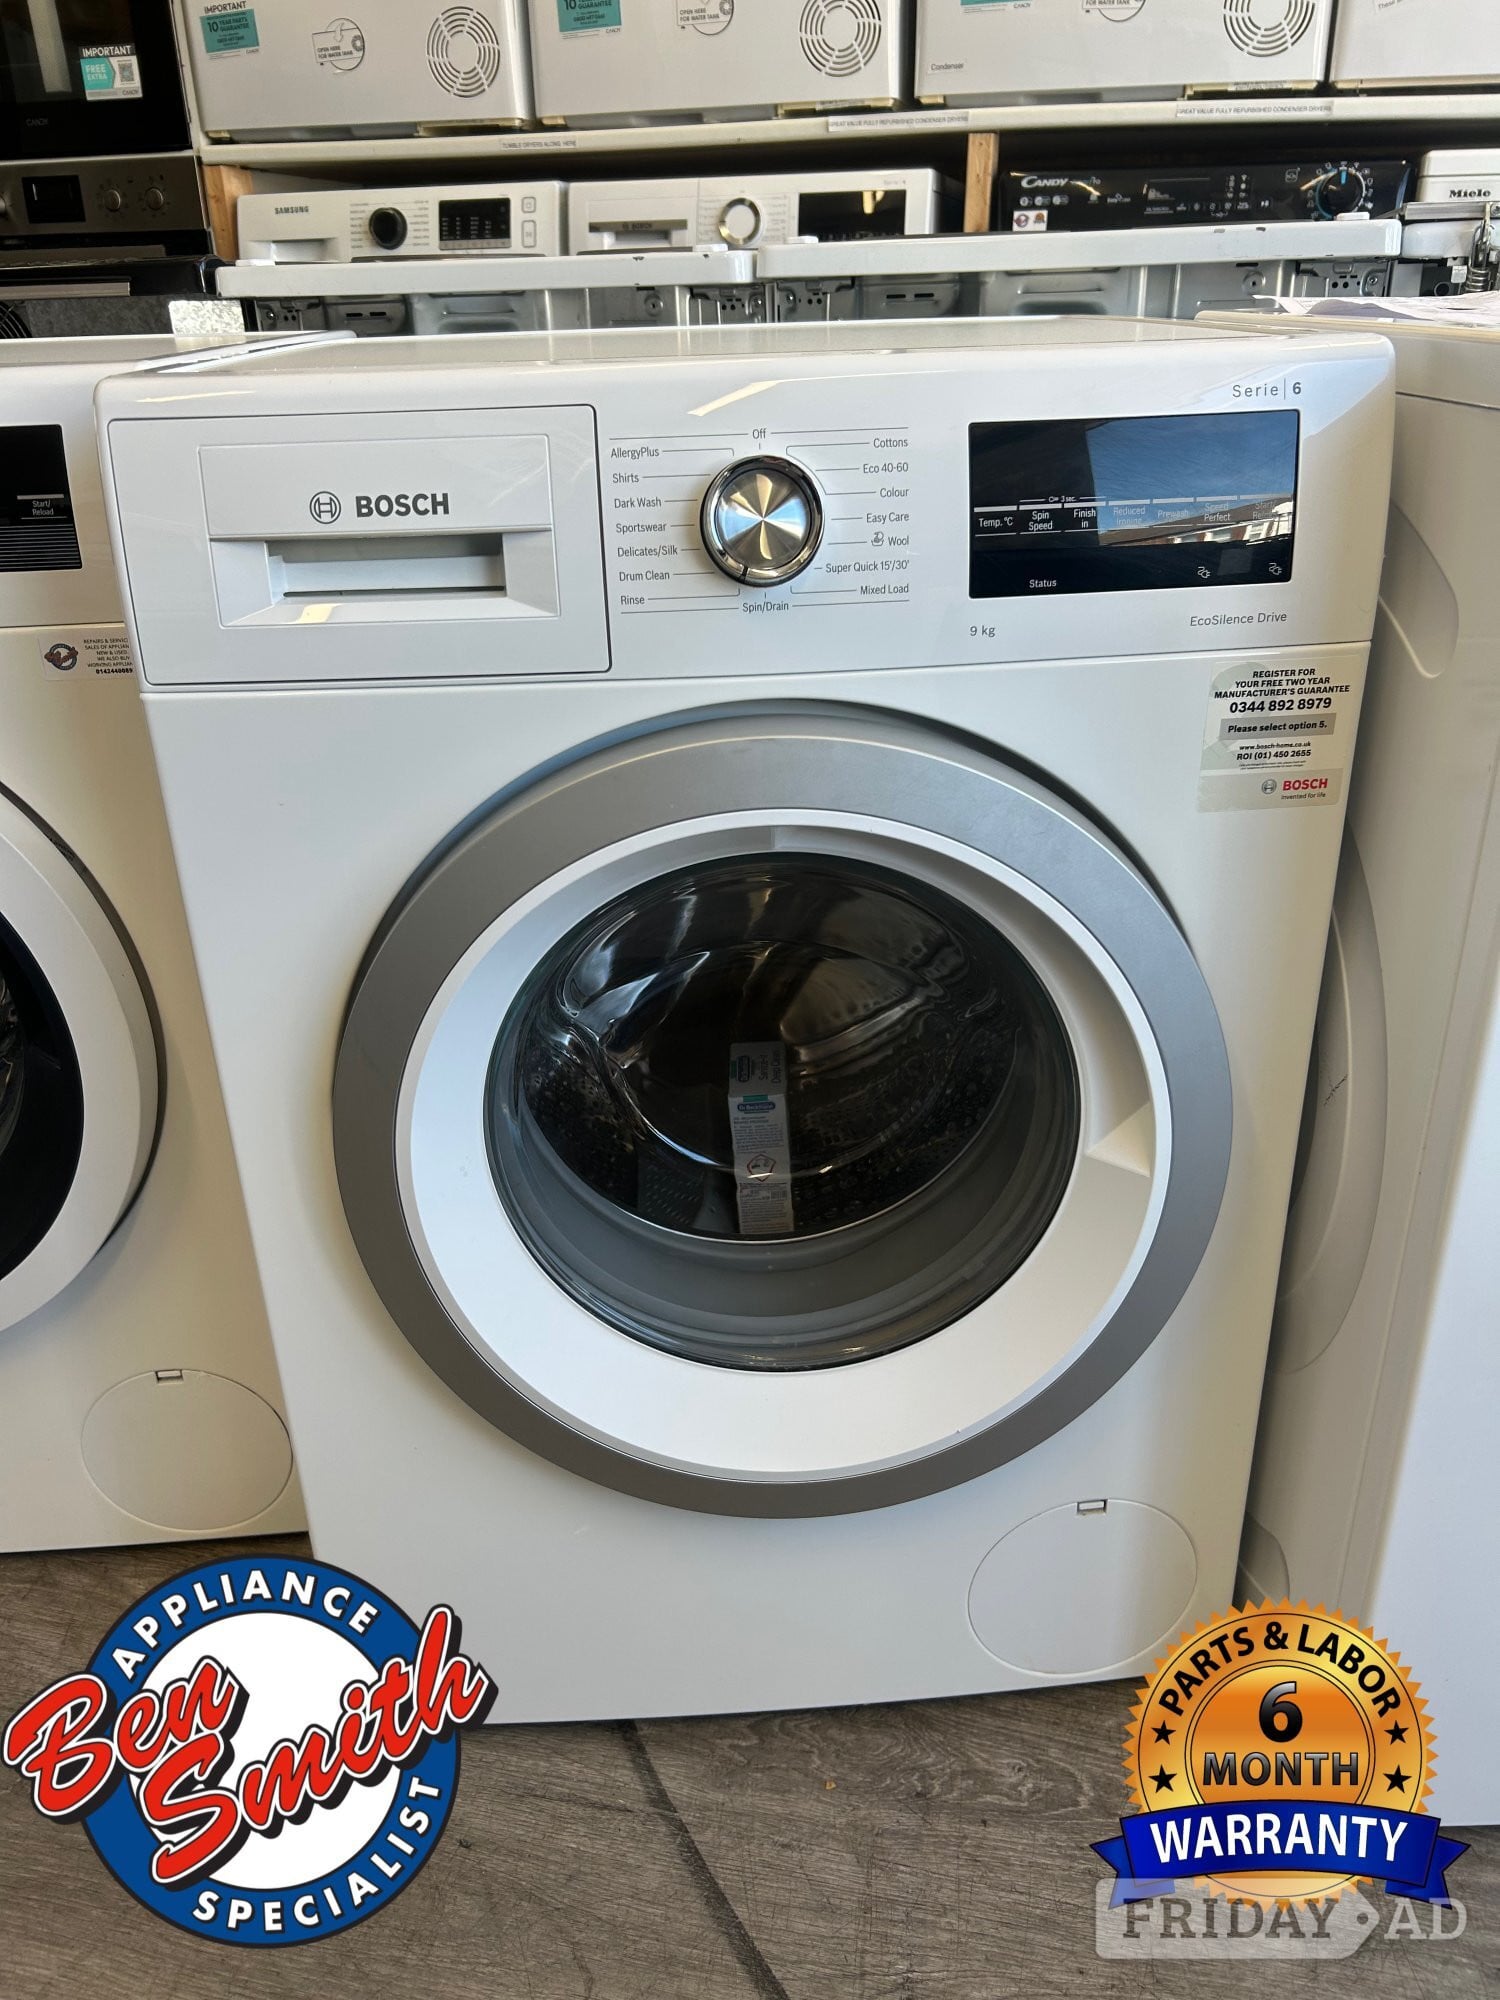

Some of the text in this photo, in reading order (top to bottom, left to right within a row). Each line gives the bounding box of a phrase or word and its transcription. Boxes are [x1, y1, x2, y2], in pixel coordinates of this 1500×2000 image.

[204, 0, 247, 14] IMPORTANT
[564, 0, 576, 10] 10
[577, 1, 612, 10] GUARANTEE
[207, 21, 219, 33] 10
[82, 45, 132, 57] IMPORTANT
[85, 64, 106, 73] FREE
[931, 62, 964, 71] Condenser
[1021, 175, 1069, 189] CANDY
[1449, 188, 1491, 198] Miele
[274, 206, 309, 214] SAMSUNG
[1232, 381, 1302, 399] Serie 6
[752, 428, 767, 440] Off
[873, 437, 909, 449] Cottons
[610, 446, 660, 460] AllergyPlus
[863, 461, 909, 474] Eco 40-60
[612, 472, 640, 484] Shirts
[880, 486, 910, 498] Colour
[355, 492, 450, 518] BOSCH
[614, 497, 662, 509] Dark Wash
[32, 507, 54, 516] Reload
[1031, 510, 1050, 522] Spin
[1073, 508, 1097, 519] Finish
[1113, 505, 1146, 516] Reduced
[1157, 509, 1189, 519] Prewash
[866, 511, 910, 525] Easy Care
[1204, 512, 1231, 522] Perfect
[616, 523, 668, 535] Sportswear
[979, 518, 1003, 529] Temp.
[1028, 520, 1053, 532] Speed
[1081, 520, 1089, 529] in
[888, 535, 910, 546] Wool
[617, 544, 678, 558] Delicates/Silk
[825, 562, 852, 574] Super
[853, 560, 879, 573] Quick
[619, 570, 670, 582] Drum Clean
[860, 583, 909, 595] Mixed Load
[1029, 577, 1057, 589] Status
[620, 595, 645, 606] Rinse
[742, 601, 789, 613] Spin/Drain
[1190, 611, 1288, 627] EcoSilence Drive
[969, 624, 996, 639] 9 kg
[1252, 668, 1316, 679] REGISTER FOR
[1235, 677, 1331, 689] YOUR FREE TWO YEAR
[1214, 685, 1351, 699] MANUFACTURER'S GUARANTEE
[1229, 697, 1332, 713] 0344 892 8979
[1227, 720, 1328, 733] Please select option 5.
[1239, 740, 1311, 751] www.bosch-home.co.uk
[1254, 751, 1272, 760] (01)
[1273, 750, 1289, 758] 450
[1290, 749, 1312, 758] 2655
[1282, 778, 1329, 791] BOSCH
[1281, 792, 1307, 800] invented
[1316, 791, 1326, 799] life
